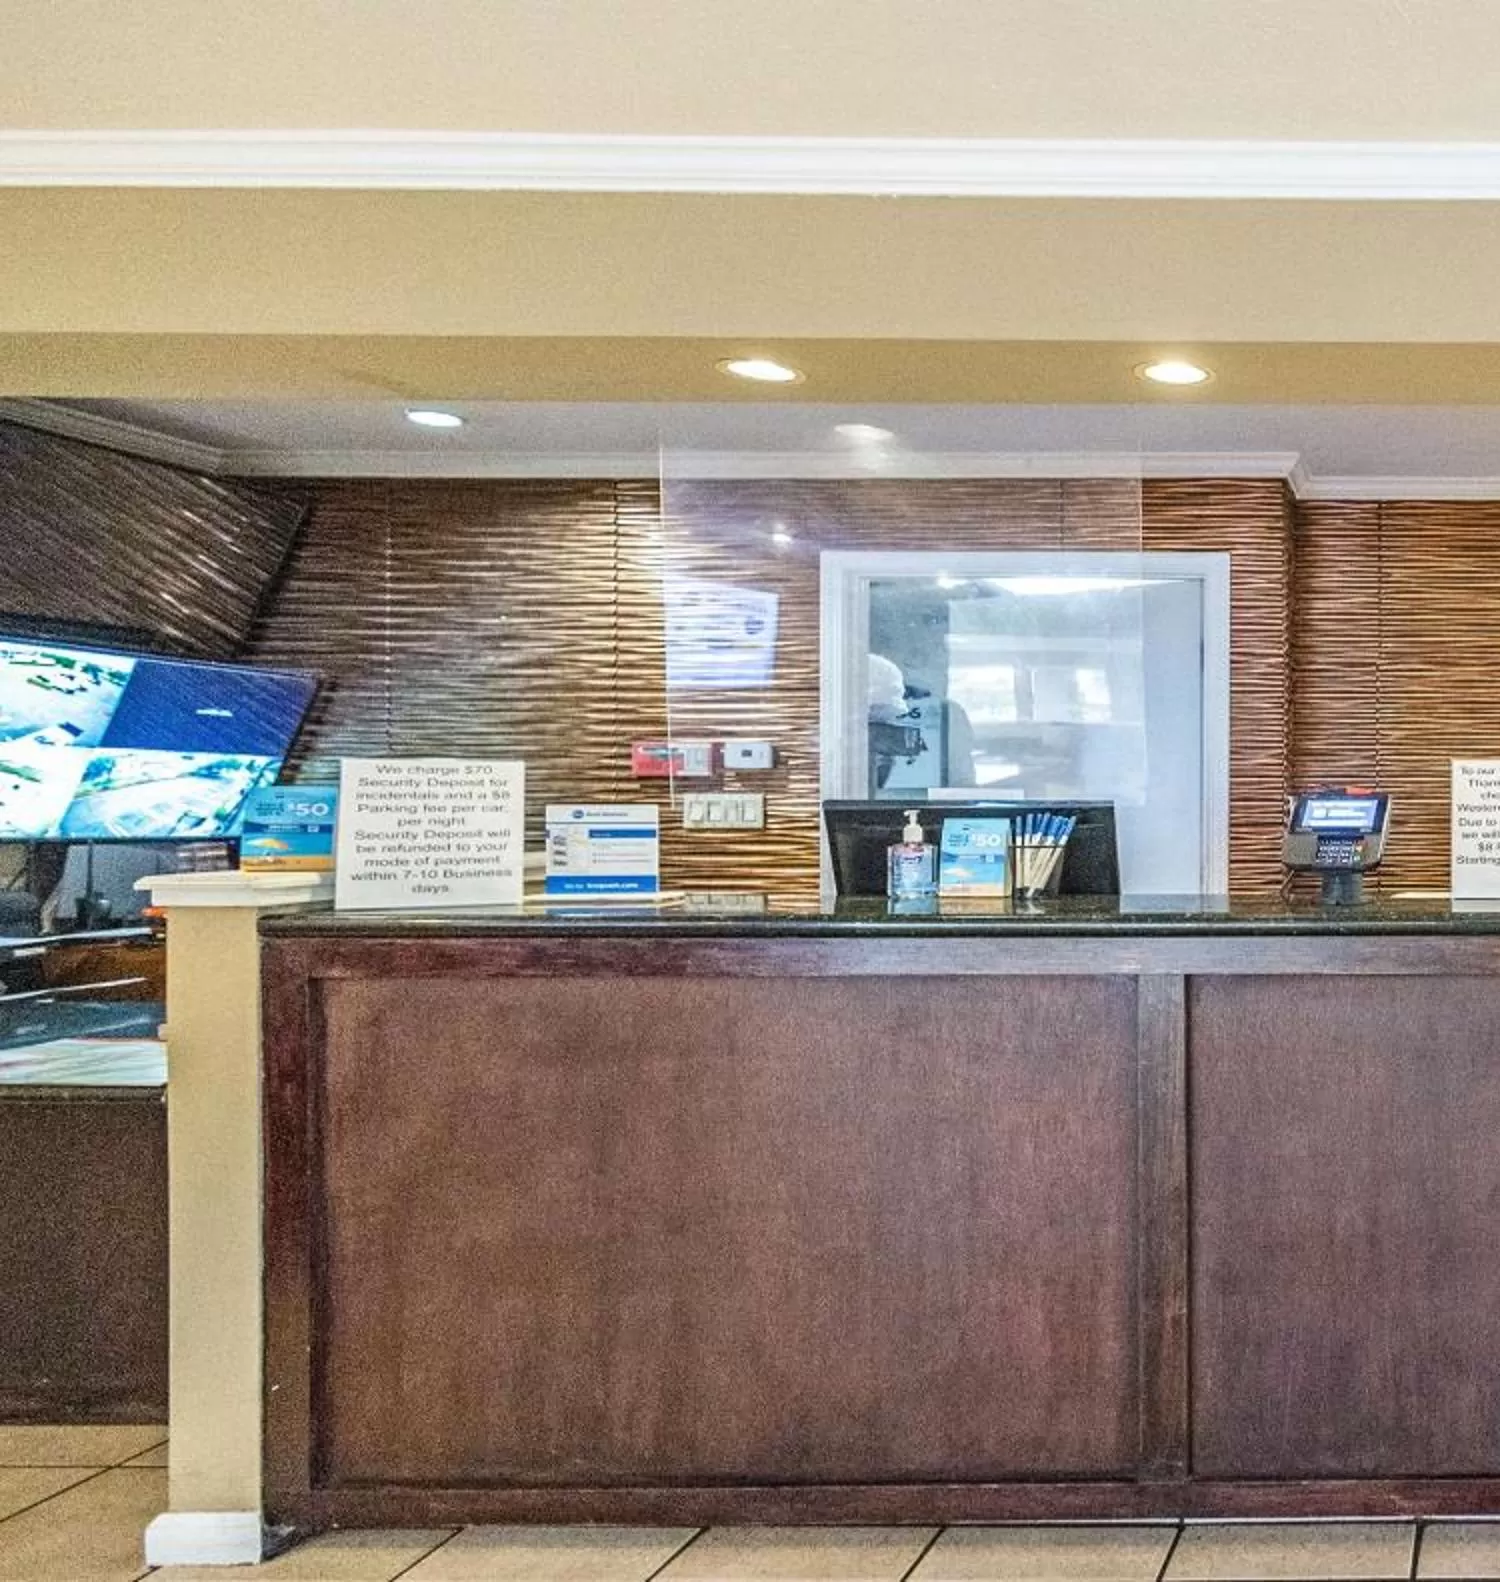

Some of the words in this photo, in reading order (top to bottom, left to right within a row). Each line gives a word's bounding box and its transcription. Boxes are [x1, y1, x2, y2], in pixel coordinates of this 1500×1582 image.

[376, 765, 403, 775] We
[406, 765, 460, 776] charge
[464, 765, 494, 775] $70
[1477, 767, 1496, 775] our
[358, 777, 422, 788] Security
[427, 777, 485, 788] Deposit
[489, 778, 508, 787] for
[355, 791, 440, 800] incidentals
[444, 791, 474, 800] and
[492, 791, 511, 800] $8
[356, 803, 419, 815] Parking
[423, 803, 448, 813] fee
[451, 805, 476, 815] per
[397, 817, 423, 828] per
[427, 815, 466, 828] night
[1458, 817, 1483, 827] Due
[1485, 818, 1498, 827] to
[354, 829, 420, 842] Security
[423, 829, 483, 841] Deposit
[487, 829, 512, 838] will
[1461, 831, 1479, 839] we
[1481, 830, 1500, 839] will
[355, 843, 377, 853] be
[381, 843, 451, 853] refunded
[455, 843, 471, 851] to
[475, 843, 508, 853] your
[364, 857, 410, 867] mode
[414, 856, 430, 867] of
[434, 856, 501, 867] payment
[351, 871, 398, 881] within
[403, 869, 438, 880] 7-10
[443, 869, 513, 880] Business
